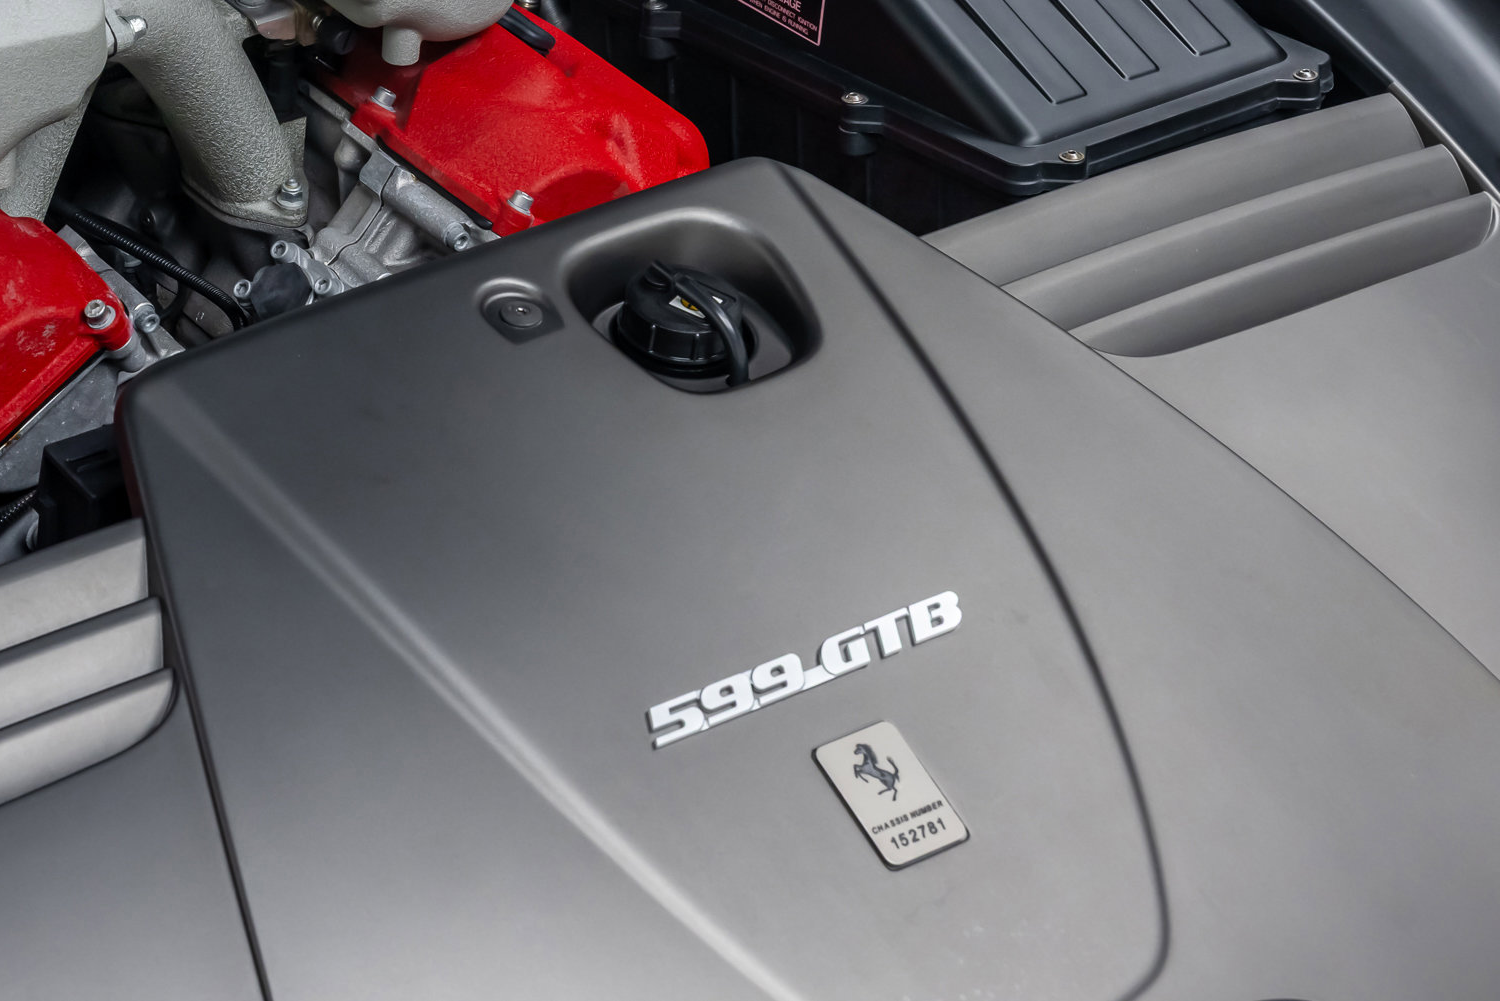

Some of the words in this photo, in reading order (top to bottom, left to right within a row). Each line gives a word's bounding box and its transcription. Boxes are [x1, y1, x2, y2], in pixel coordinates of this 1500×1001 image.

[647, 652, 805, 749] 599
[818, 590, 963, 676] GTB
[871, 814, 909, 834] CHASSIS
[909, 800, 943, 818] NUMBER
[890, 817, 946, 849] 152781
